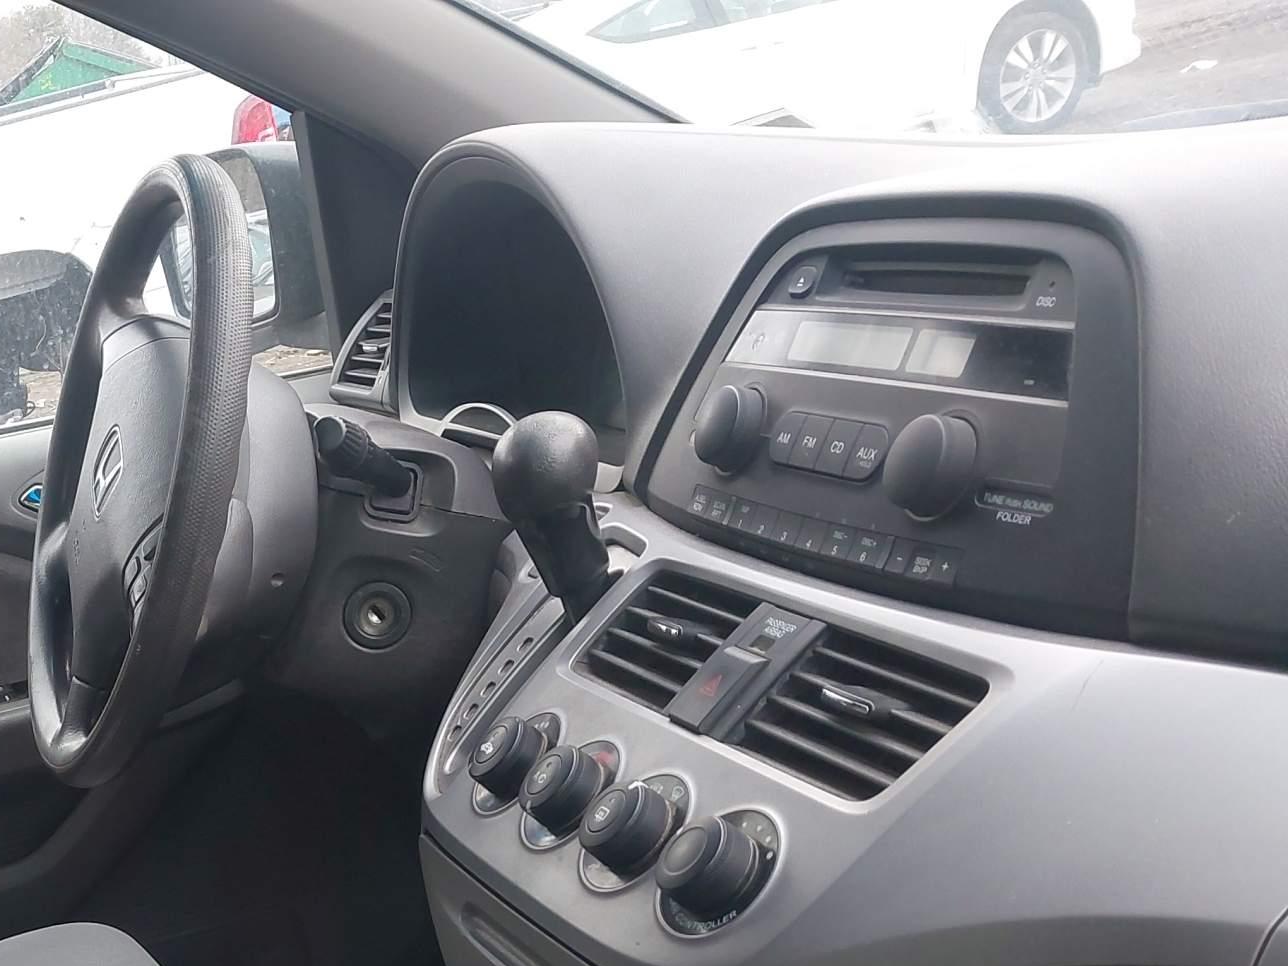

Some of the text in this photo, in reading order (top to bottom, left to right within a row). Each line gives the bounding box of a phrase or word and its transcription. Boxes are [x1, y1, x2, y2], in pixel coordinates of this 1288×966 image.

[1035, 296, 1057, 308] DISC
[776, 431, 792, 445] AM
[802, 435, 817, 449] FM
[830, 441, 845, 454] CD
[855, 447, 878, 461] AUX
[1022, 498, 1054, 513] SOUND
[995, 511, 1032, 526] FOLDER
[757, 524, 765, 535] 2
[780, 531, 787, 541] 3
[831, 545, 838, 555] 5
[859, 551, 867, 562] 6
[764, 625, 786, 638] AIRBAG
[675, 909, 737, 932] CONTROLLER
